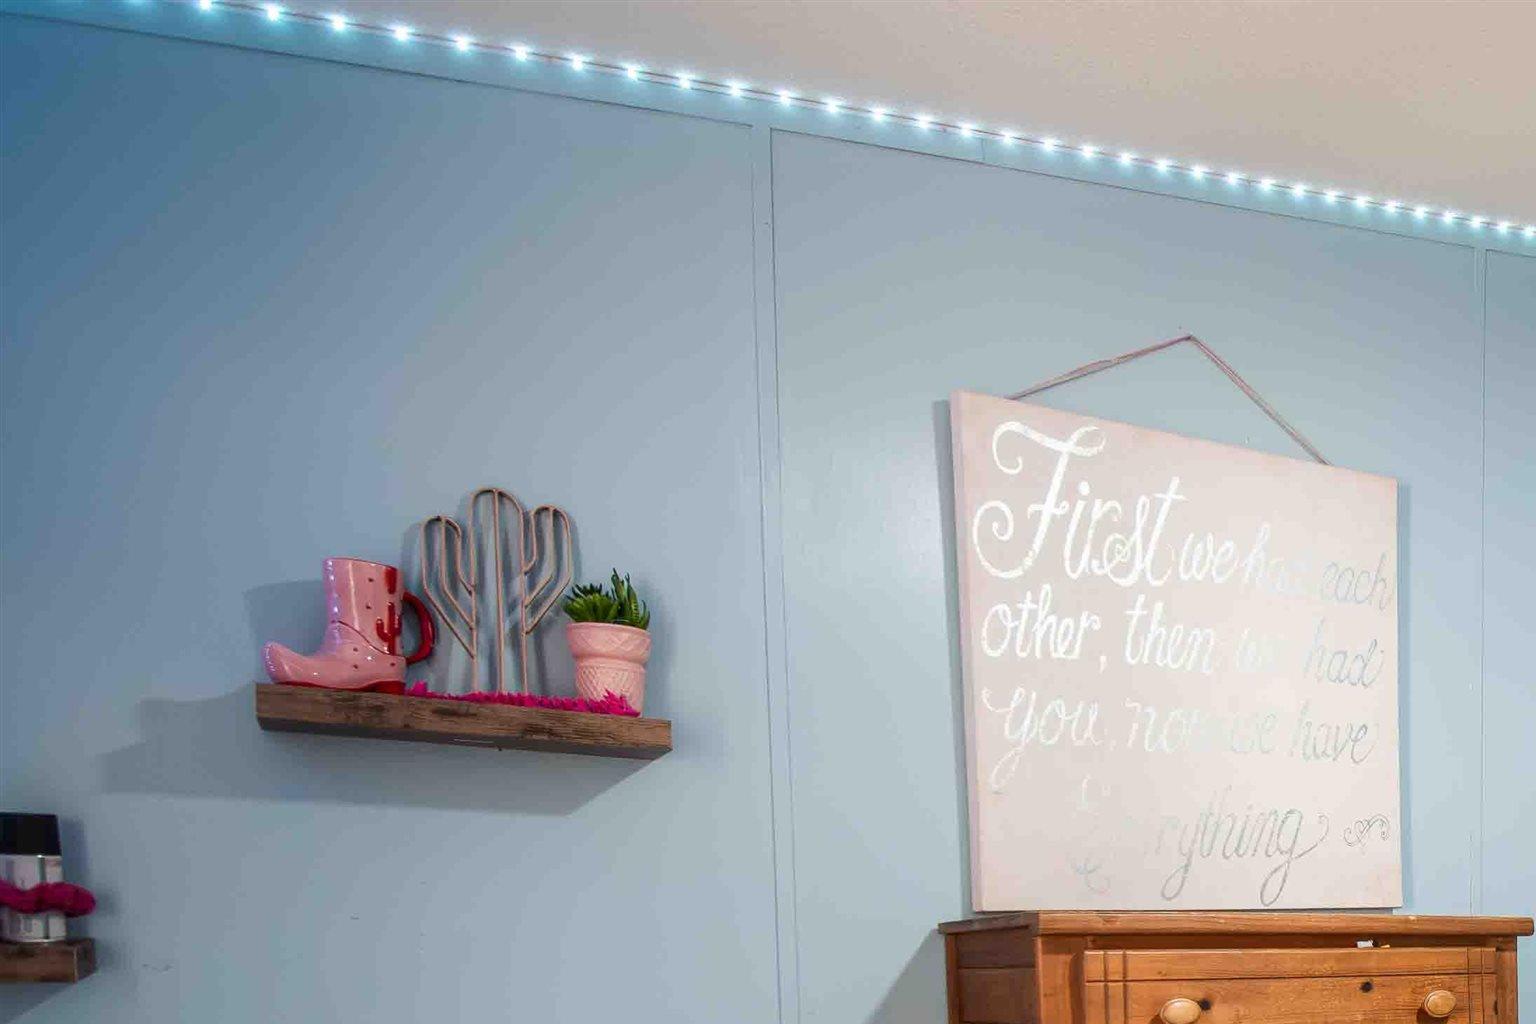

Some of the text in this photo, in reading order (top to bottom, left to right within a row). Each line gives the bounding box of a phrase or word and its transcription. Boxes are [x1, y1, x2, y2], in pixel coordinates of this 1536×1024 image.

[973, 421, 1189, 587] First
[1180, 532, 1238, 584] we
[1319, 552, 1392, 612] each
[981, 583, 1108, 673] other,
[1123, 593, 1216, 677] then
[1302, 616, 1385, 689] had
[1288, 699, 1379, 765] have
